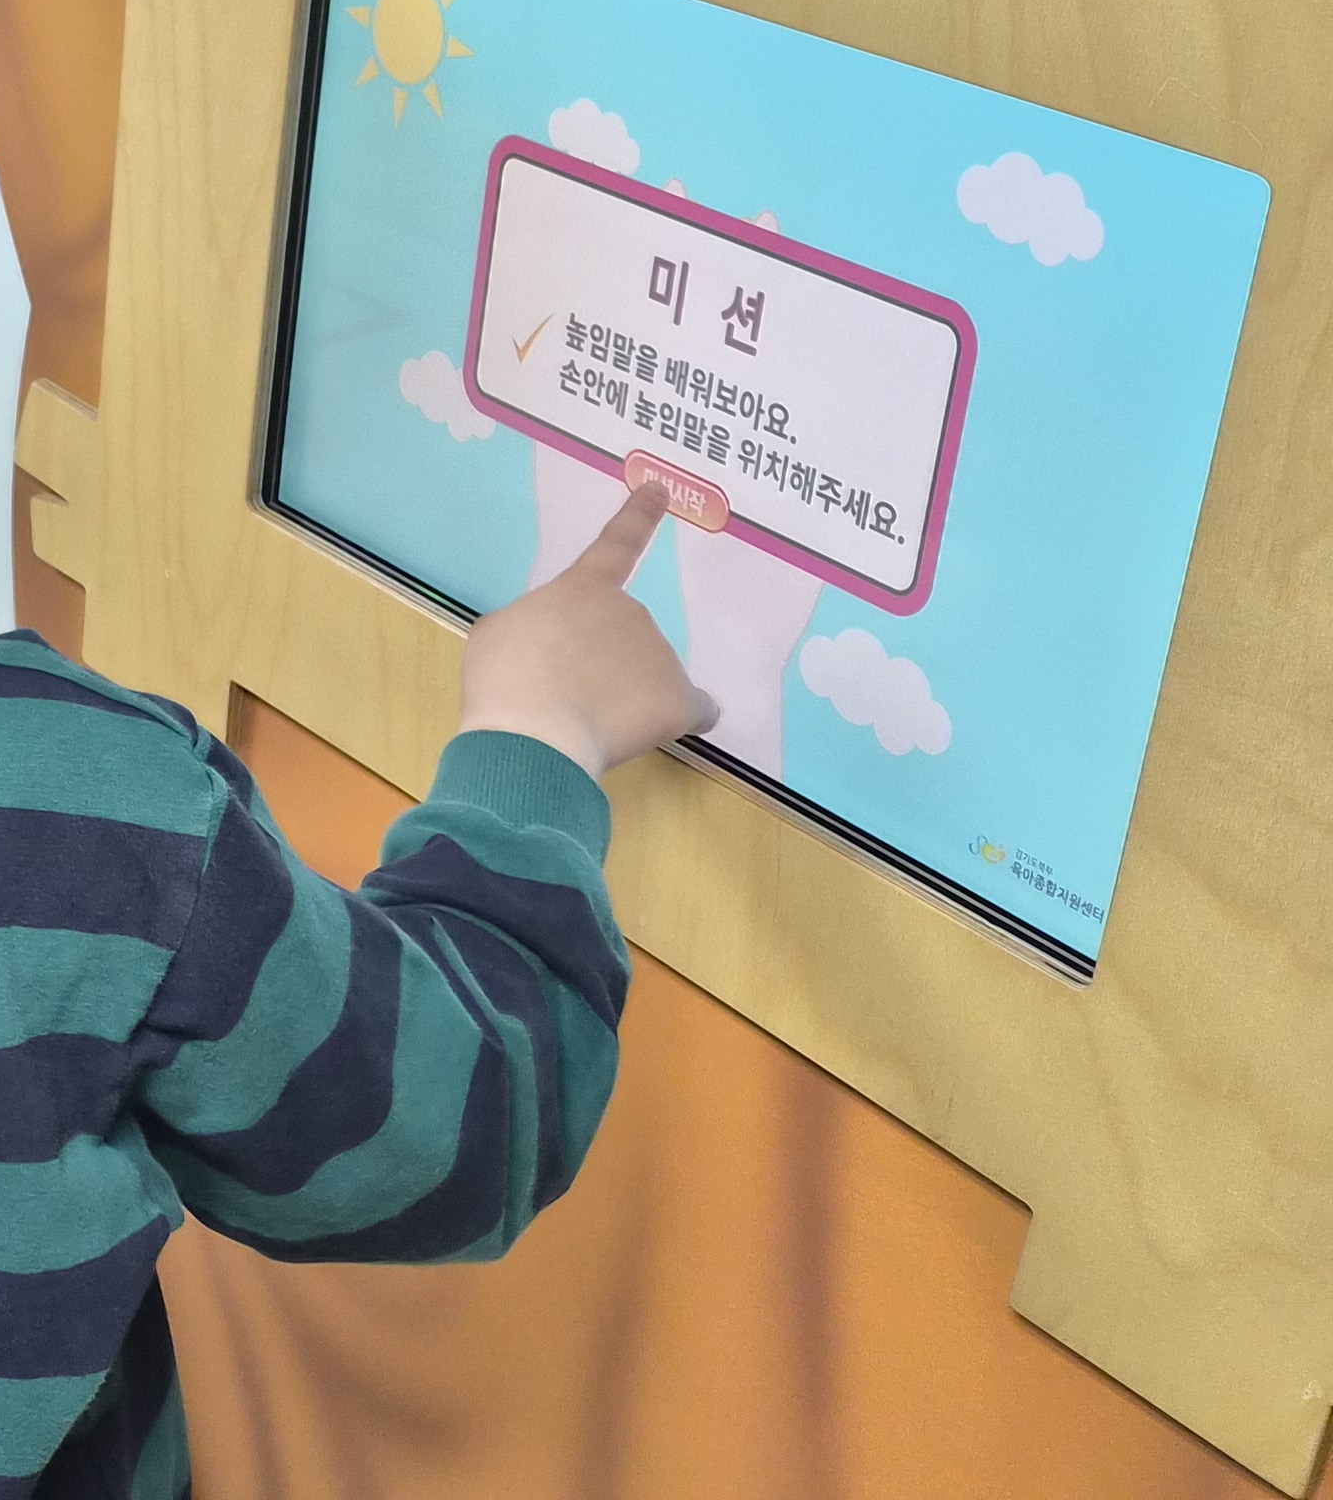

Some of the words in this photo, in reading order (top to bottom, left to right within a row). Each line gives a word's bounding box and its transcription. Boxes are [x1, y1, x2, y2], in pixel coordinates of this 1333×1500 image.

[564, 313, 660, 384] 높임말을
[664, 355, 798, 445] 배워보아요.
[558, 359, 629, 420] 손안에
[633, 392, 732, 466] 높임말을
[737, 439, 906, 546] 위치해주세요.
[1011, 861, 1105, 924] 육아종합지원센터
